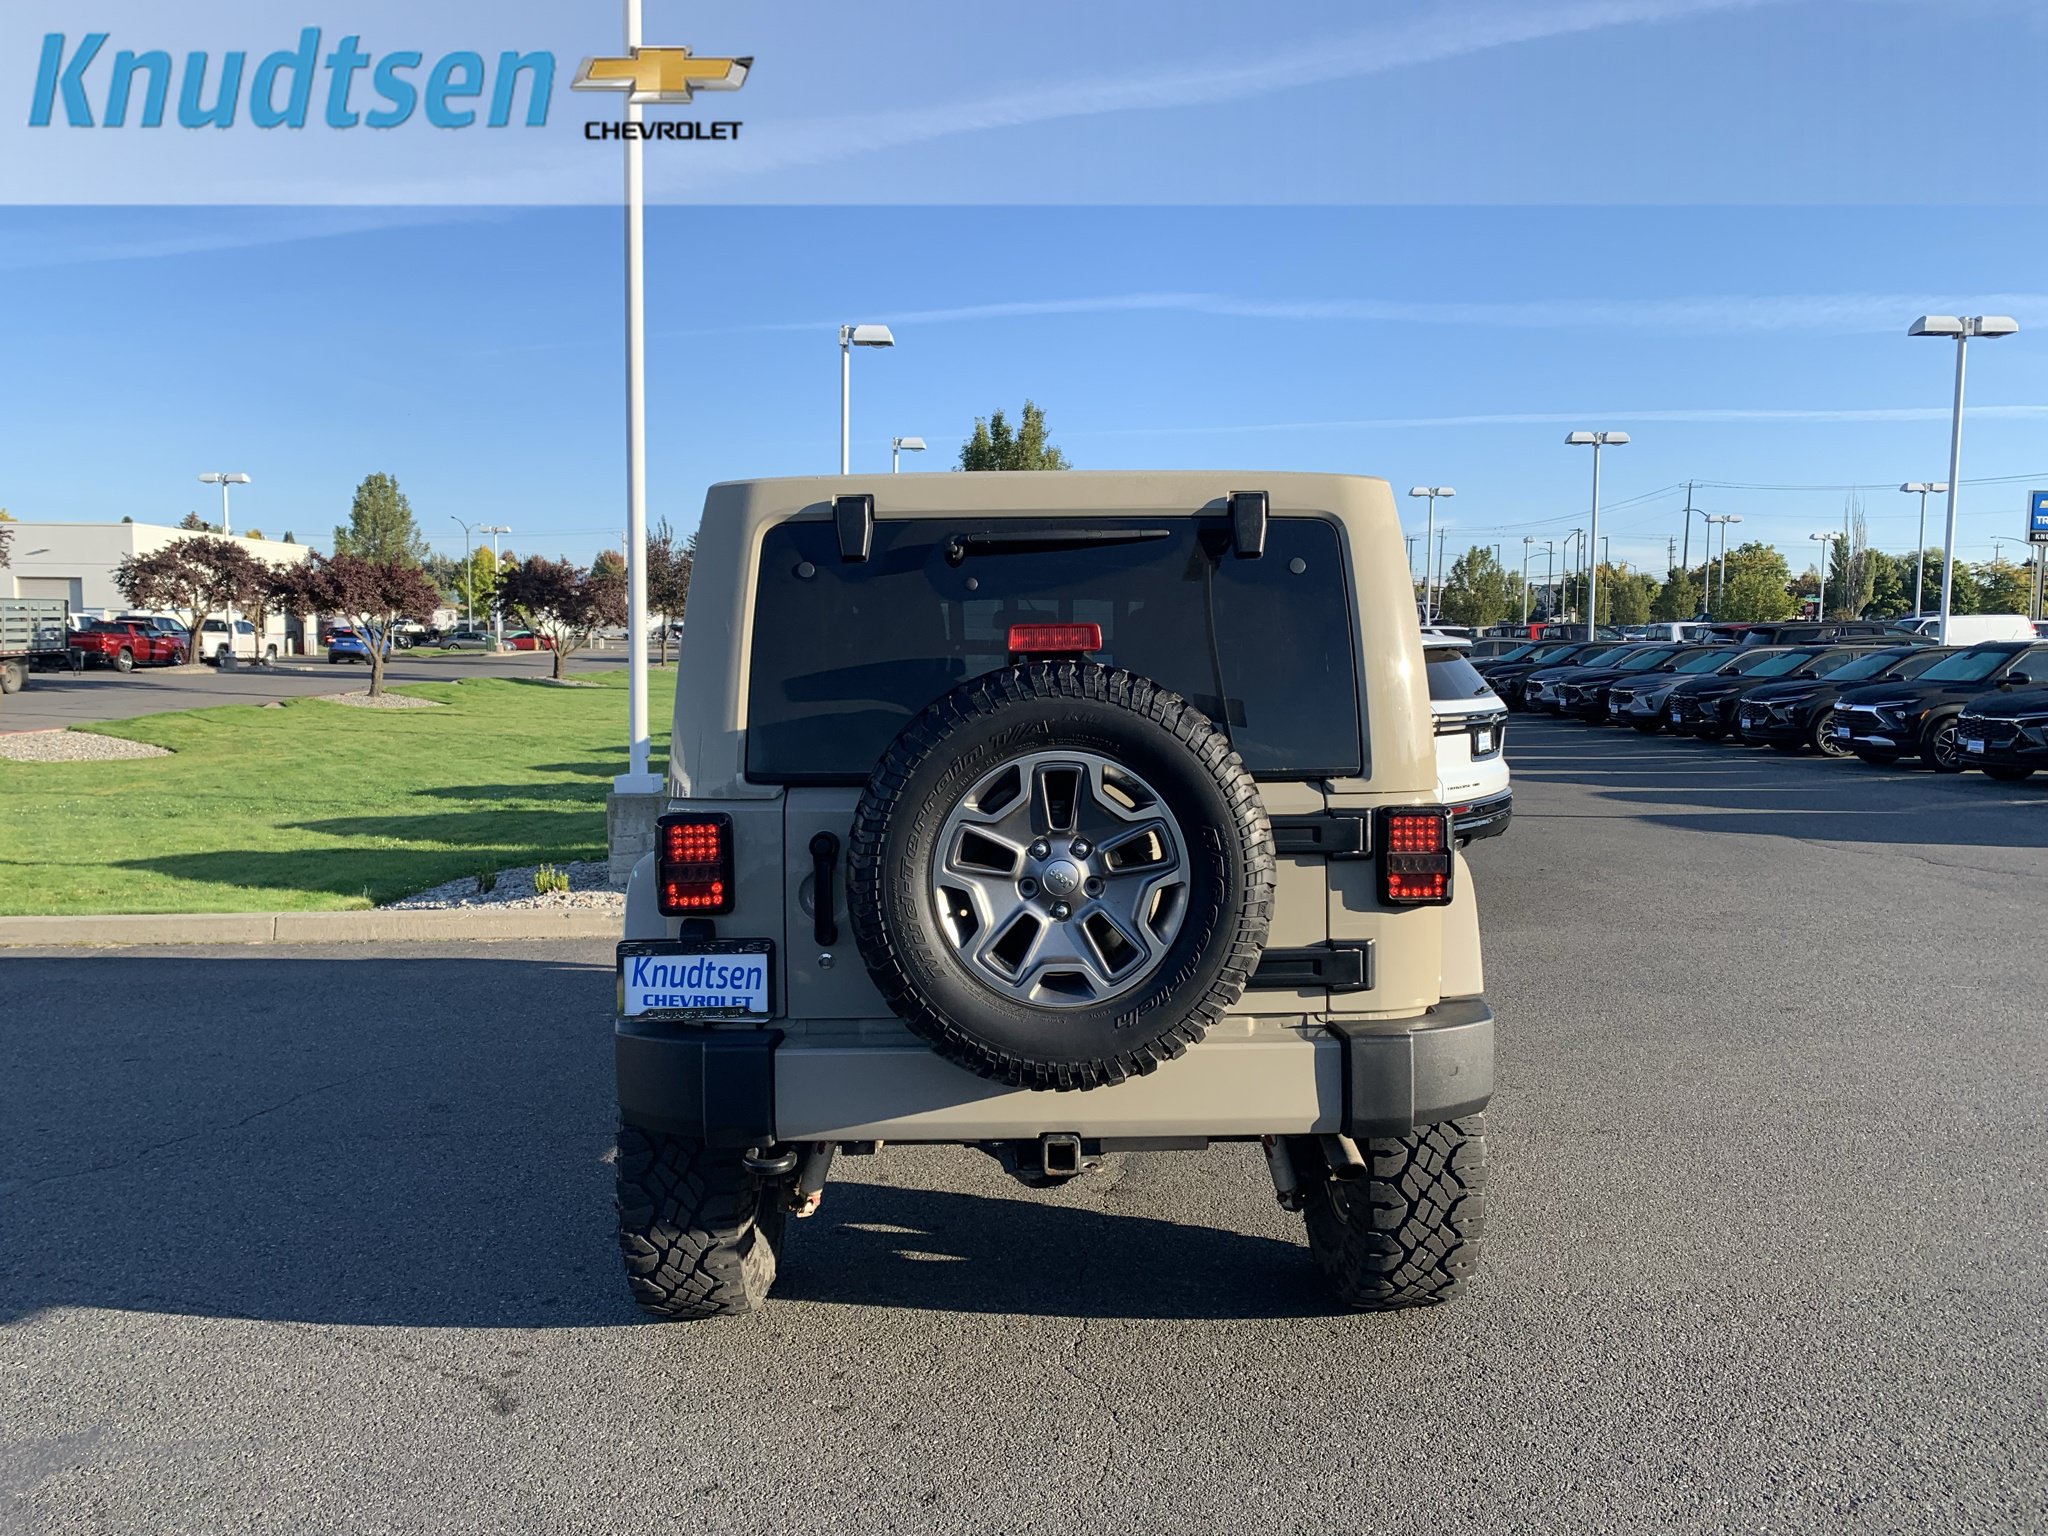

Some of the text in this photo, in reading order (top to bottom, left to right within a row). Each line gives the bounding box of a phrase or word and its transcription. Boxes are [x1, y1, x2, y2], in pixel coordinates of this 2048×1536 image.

[896, 736, 987, 986] Mud-Terrain
[1049, 868, 1074, 889] Jeep
[1112, 820, 1226, 1032] BFGoodrich
[632, 957, 762, 990] Knudtsen
[643, 994, 754, 1009] CHEVROLET
